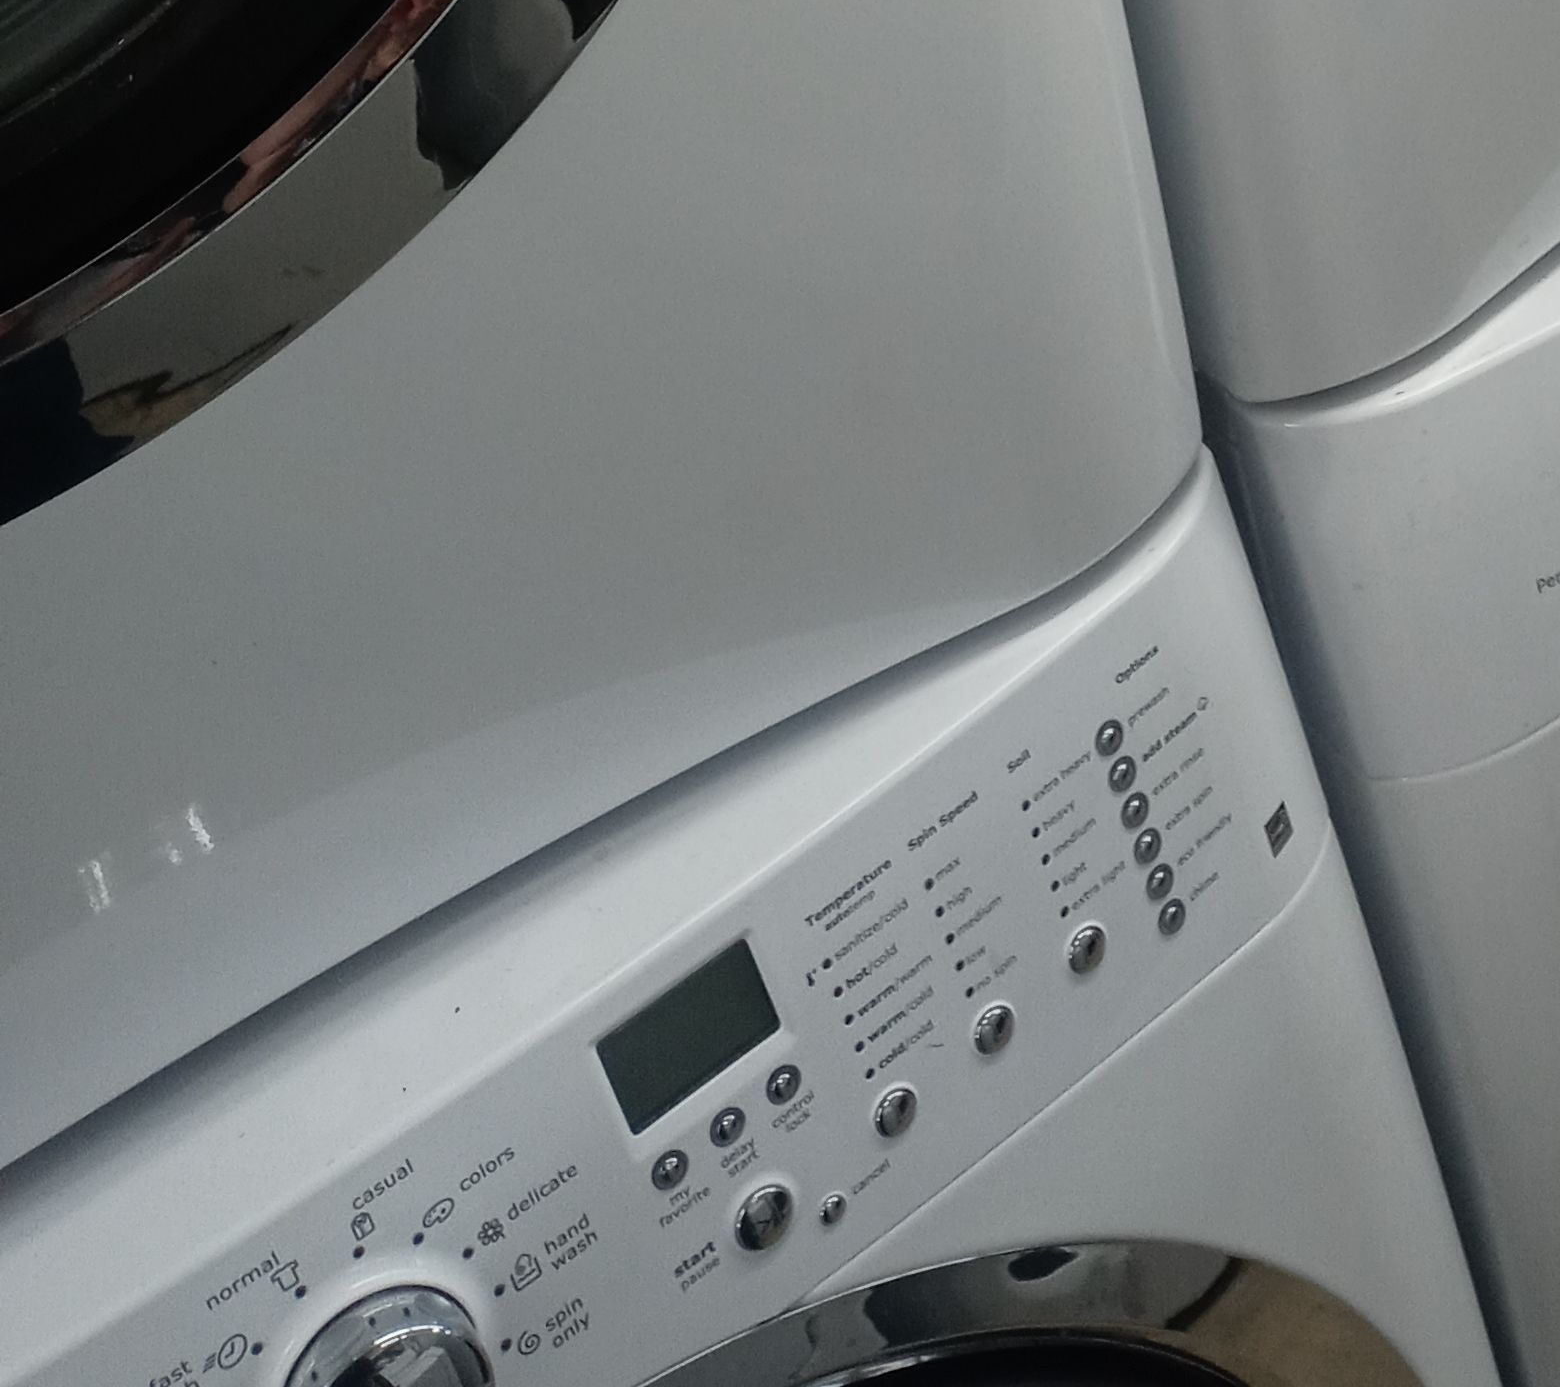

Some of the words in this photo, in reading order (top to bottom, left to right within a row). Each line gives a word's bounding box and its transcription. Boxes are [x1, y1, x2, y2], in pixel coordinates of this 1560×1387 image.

[1115, 645, 1160, 684] Options
[1006, 748, 1032, 774] Soil
[907, 825, 938, 852] Spin
[938, 790, 979, 828] Speed
[935, 857, 961, 881] max
[804, 859, 893, 927] Temperature
[845, 942, 898, 989] hot/cold
[857, 954, 933, 1017] warm/warm
[867, 985, 935, 1043] warm/cold
[878, 1019, 935, 1070] cold/cold
[771, 1089, 816, 1129] control
[459, 1146, 516, 1192] colors
[720, 1137, 755, 1169] delay
[727, 1148, 761, 1179] start
[352, 1158, 415, 1211] casual
[507, 1164, 578, 1222] delicate
[669, 1186, 691, 1207] my
[852, 1158, 892, 1196] cancel
[659, 1186, 711, 1228] favorite
[543, 1213, 591, 1256] hand
[550, 1229, 599, 1271] wash
[674, 1240, 717, 1278] start
[680, 1257, 721, 1293] pause
[206, 1250, 281, 1312] normal
[545, 1296, 584, 1333] spin
[552, 1312, 591, 1349] only
